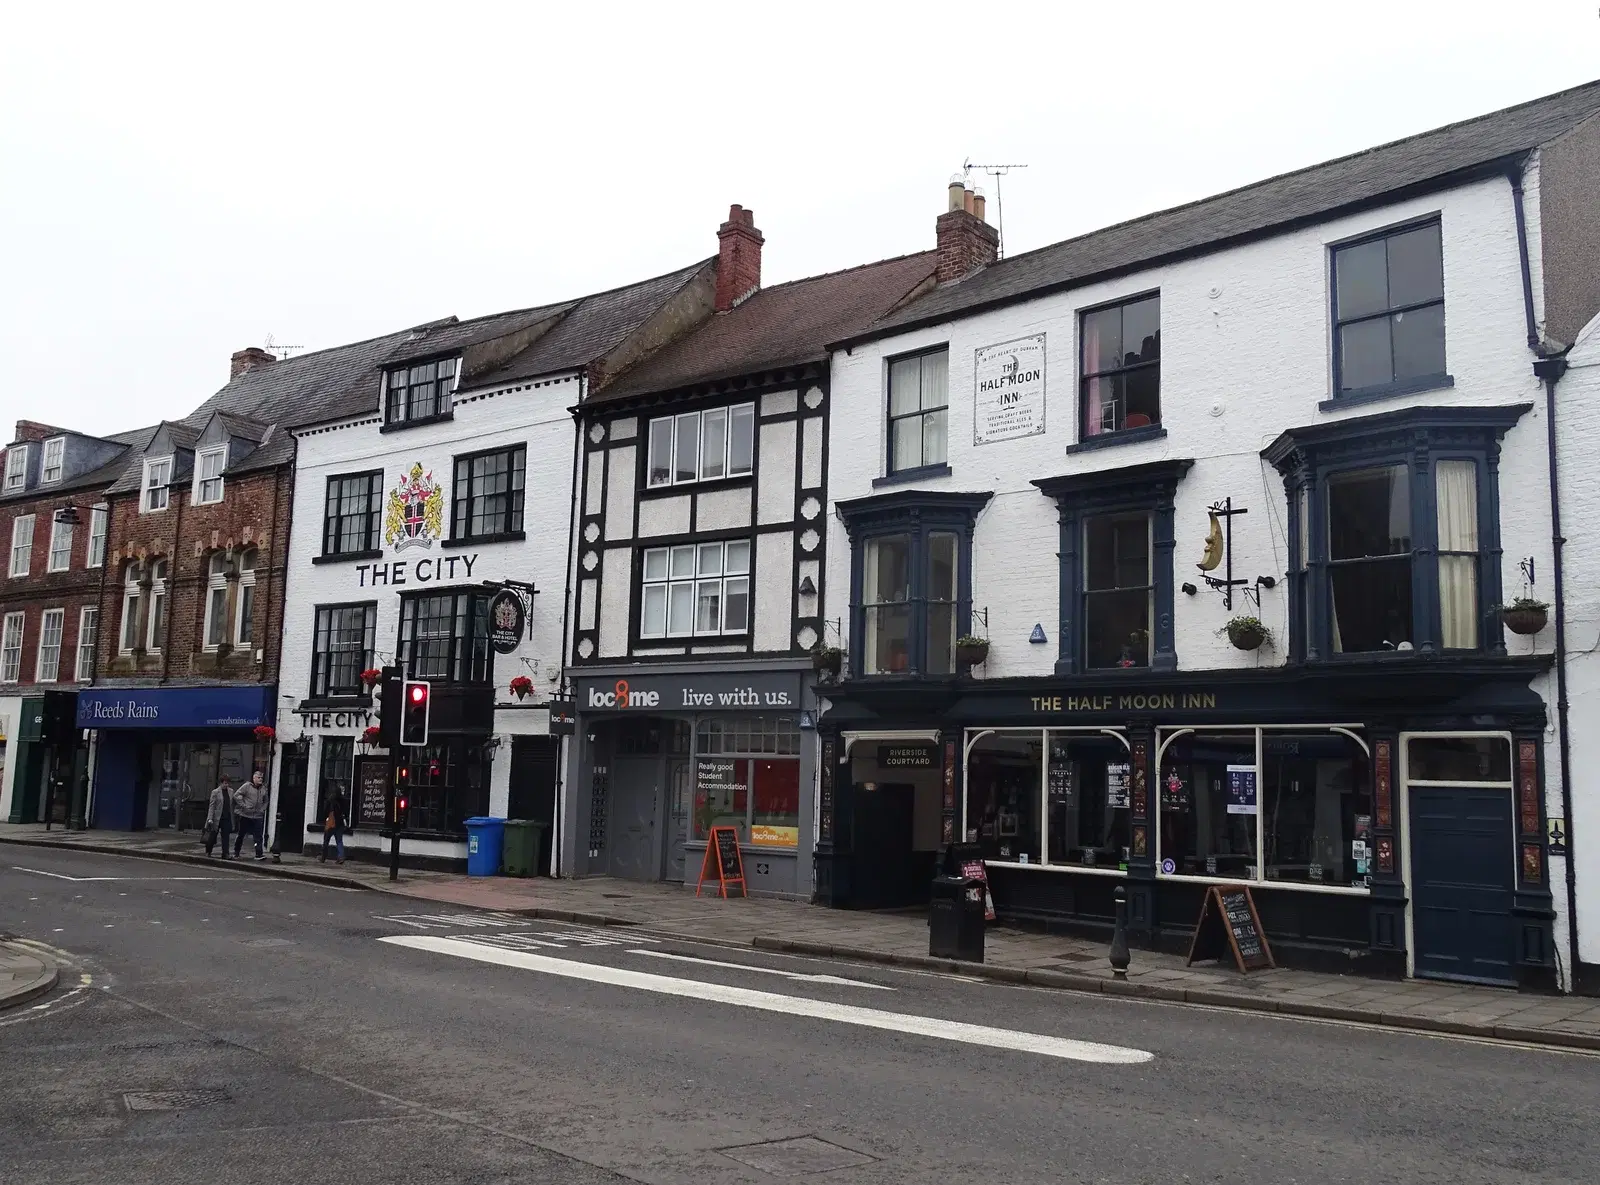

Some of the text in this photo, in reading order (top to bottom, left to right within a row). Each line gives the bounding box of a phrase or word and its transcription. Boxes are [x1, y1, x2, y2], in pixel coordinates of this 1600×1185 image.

[1002, 362, 1017, 372] THE
[980, 370, 1040, 392] HALF MOON
[1000, 392, 1018, 405] INN
[1010, 422, 1032, 430] COCKTAILS
[356, 554, 478, 587] THE CITY
[588, 680, 792, 708] loc8me live with us.
[1031, 693, 1216, 711] THE HALF MOON INN
[94, 700, 159, 718] Reeds Rains
[301, 712, 372, 728] THE CITY
[698, 762, 734, 772] Really good
[698, 782, 747, 790] Accommodation
